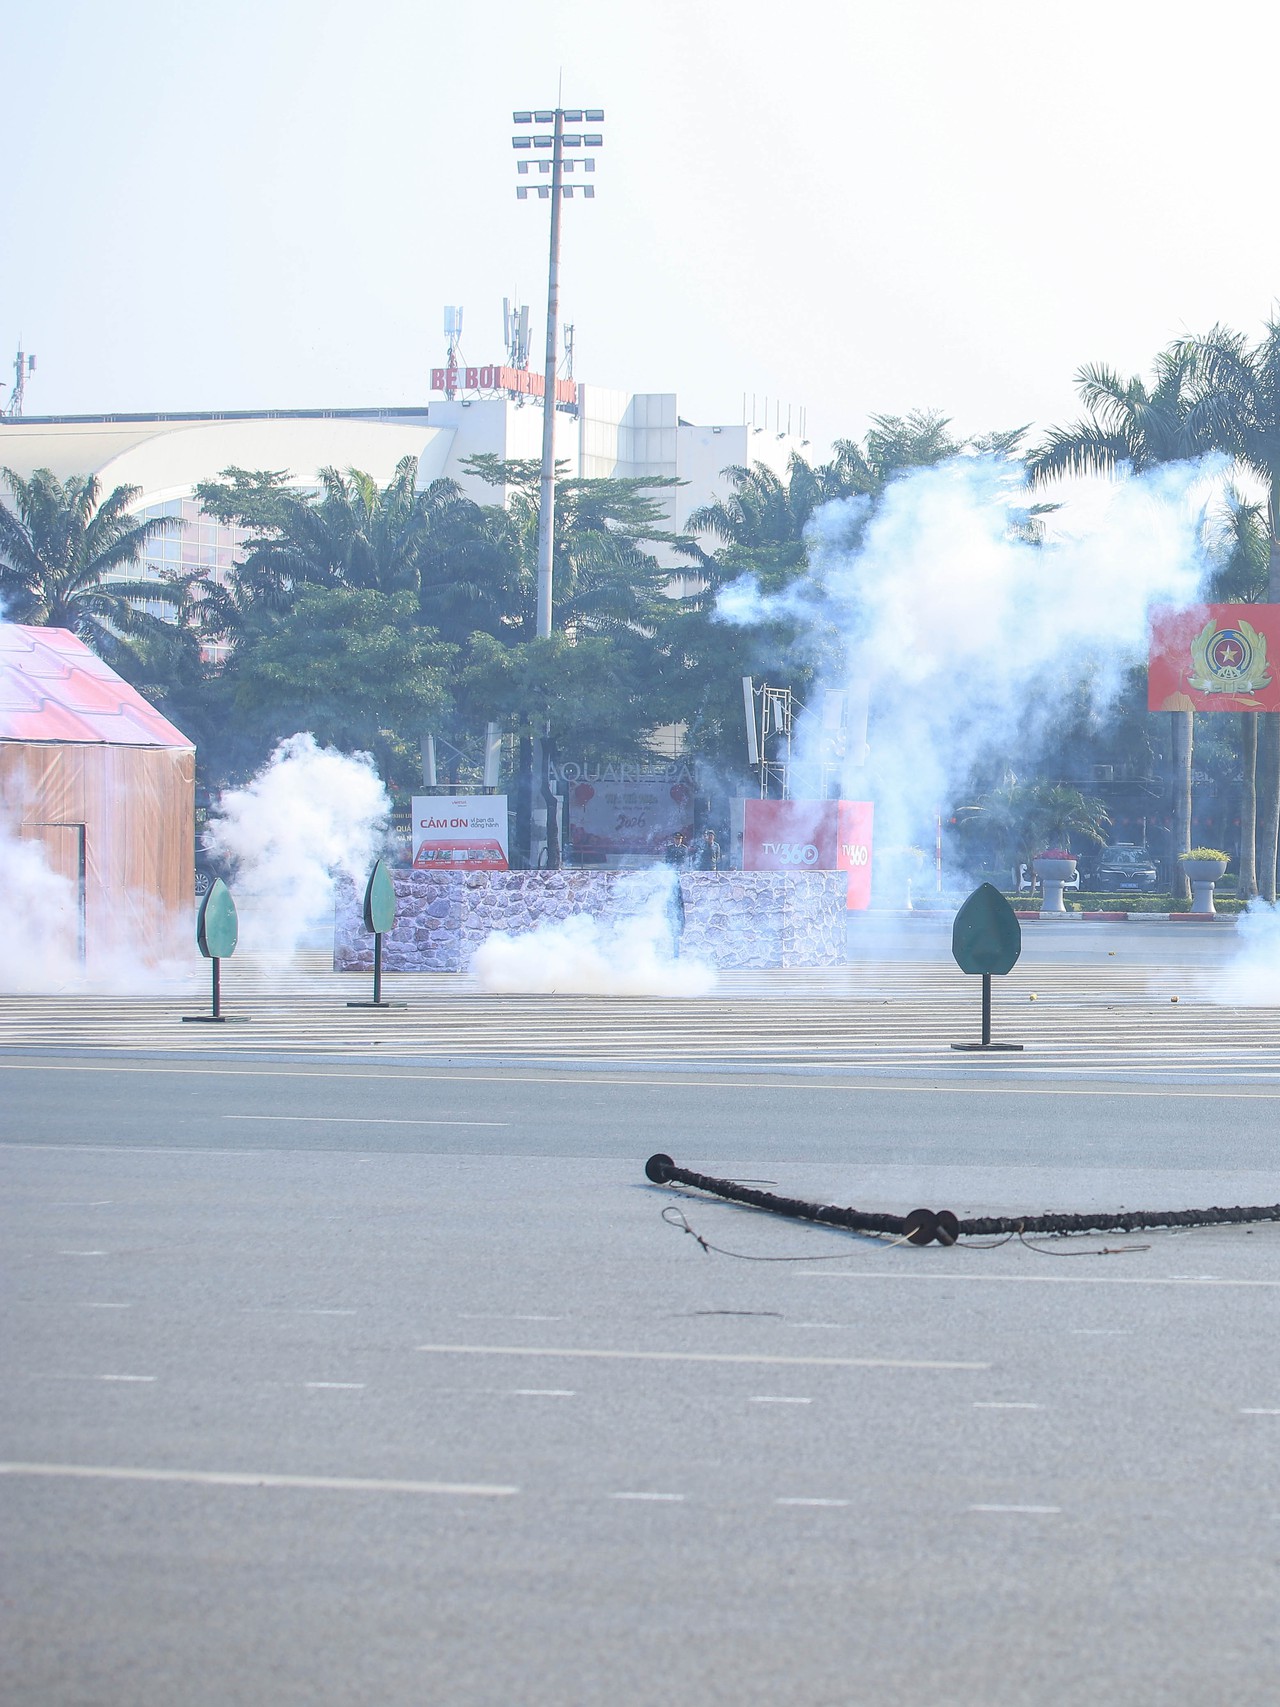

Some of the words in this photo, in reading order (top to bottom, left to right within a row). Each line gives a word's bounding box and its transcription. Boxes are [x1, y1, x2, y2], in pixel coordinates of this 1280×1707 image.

[420, 816, 447, 828] CẢM
[450, 818, 468, 828] ƠN
[762, 843, 819, 865] TV360
[842, 844, 868, 866] TV360
